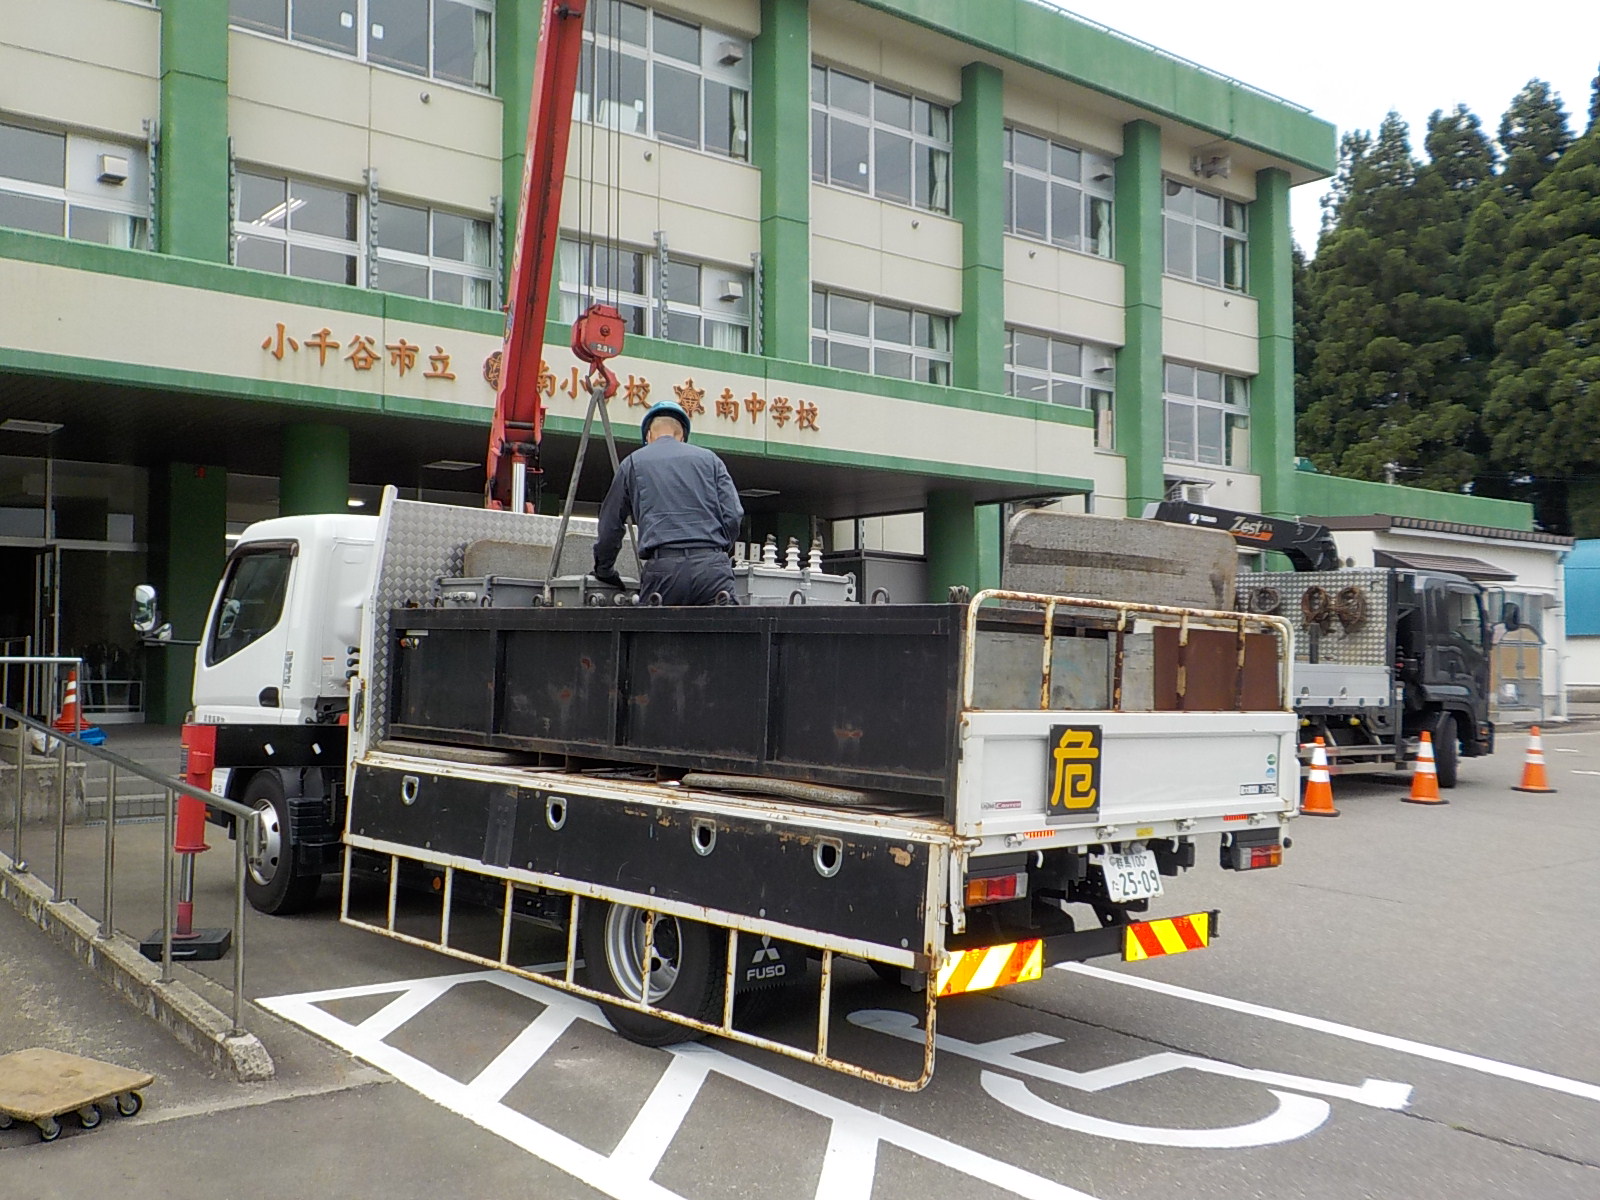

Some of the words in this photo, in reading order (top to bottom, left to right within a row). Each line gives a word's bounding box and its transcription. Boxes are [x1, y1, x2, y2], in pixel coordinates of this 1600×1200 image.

[261, 322, 457, 381] 小千谷市立
[715, 387, 820, 432] 南中学校
[1229, 515, 1263, 536] Zest
[1051, 728, 1099, 809] 危
[746, 964, 786, 982] FUSO
